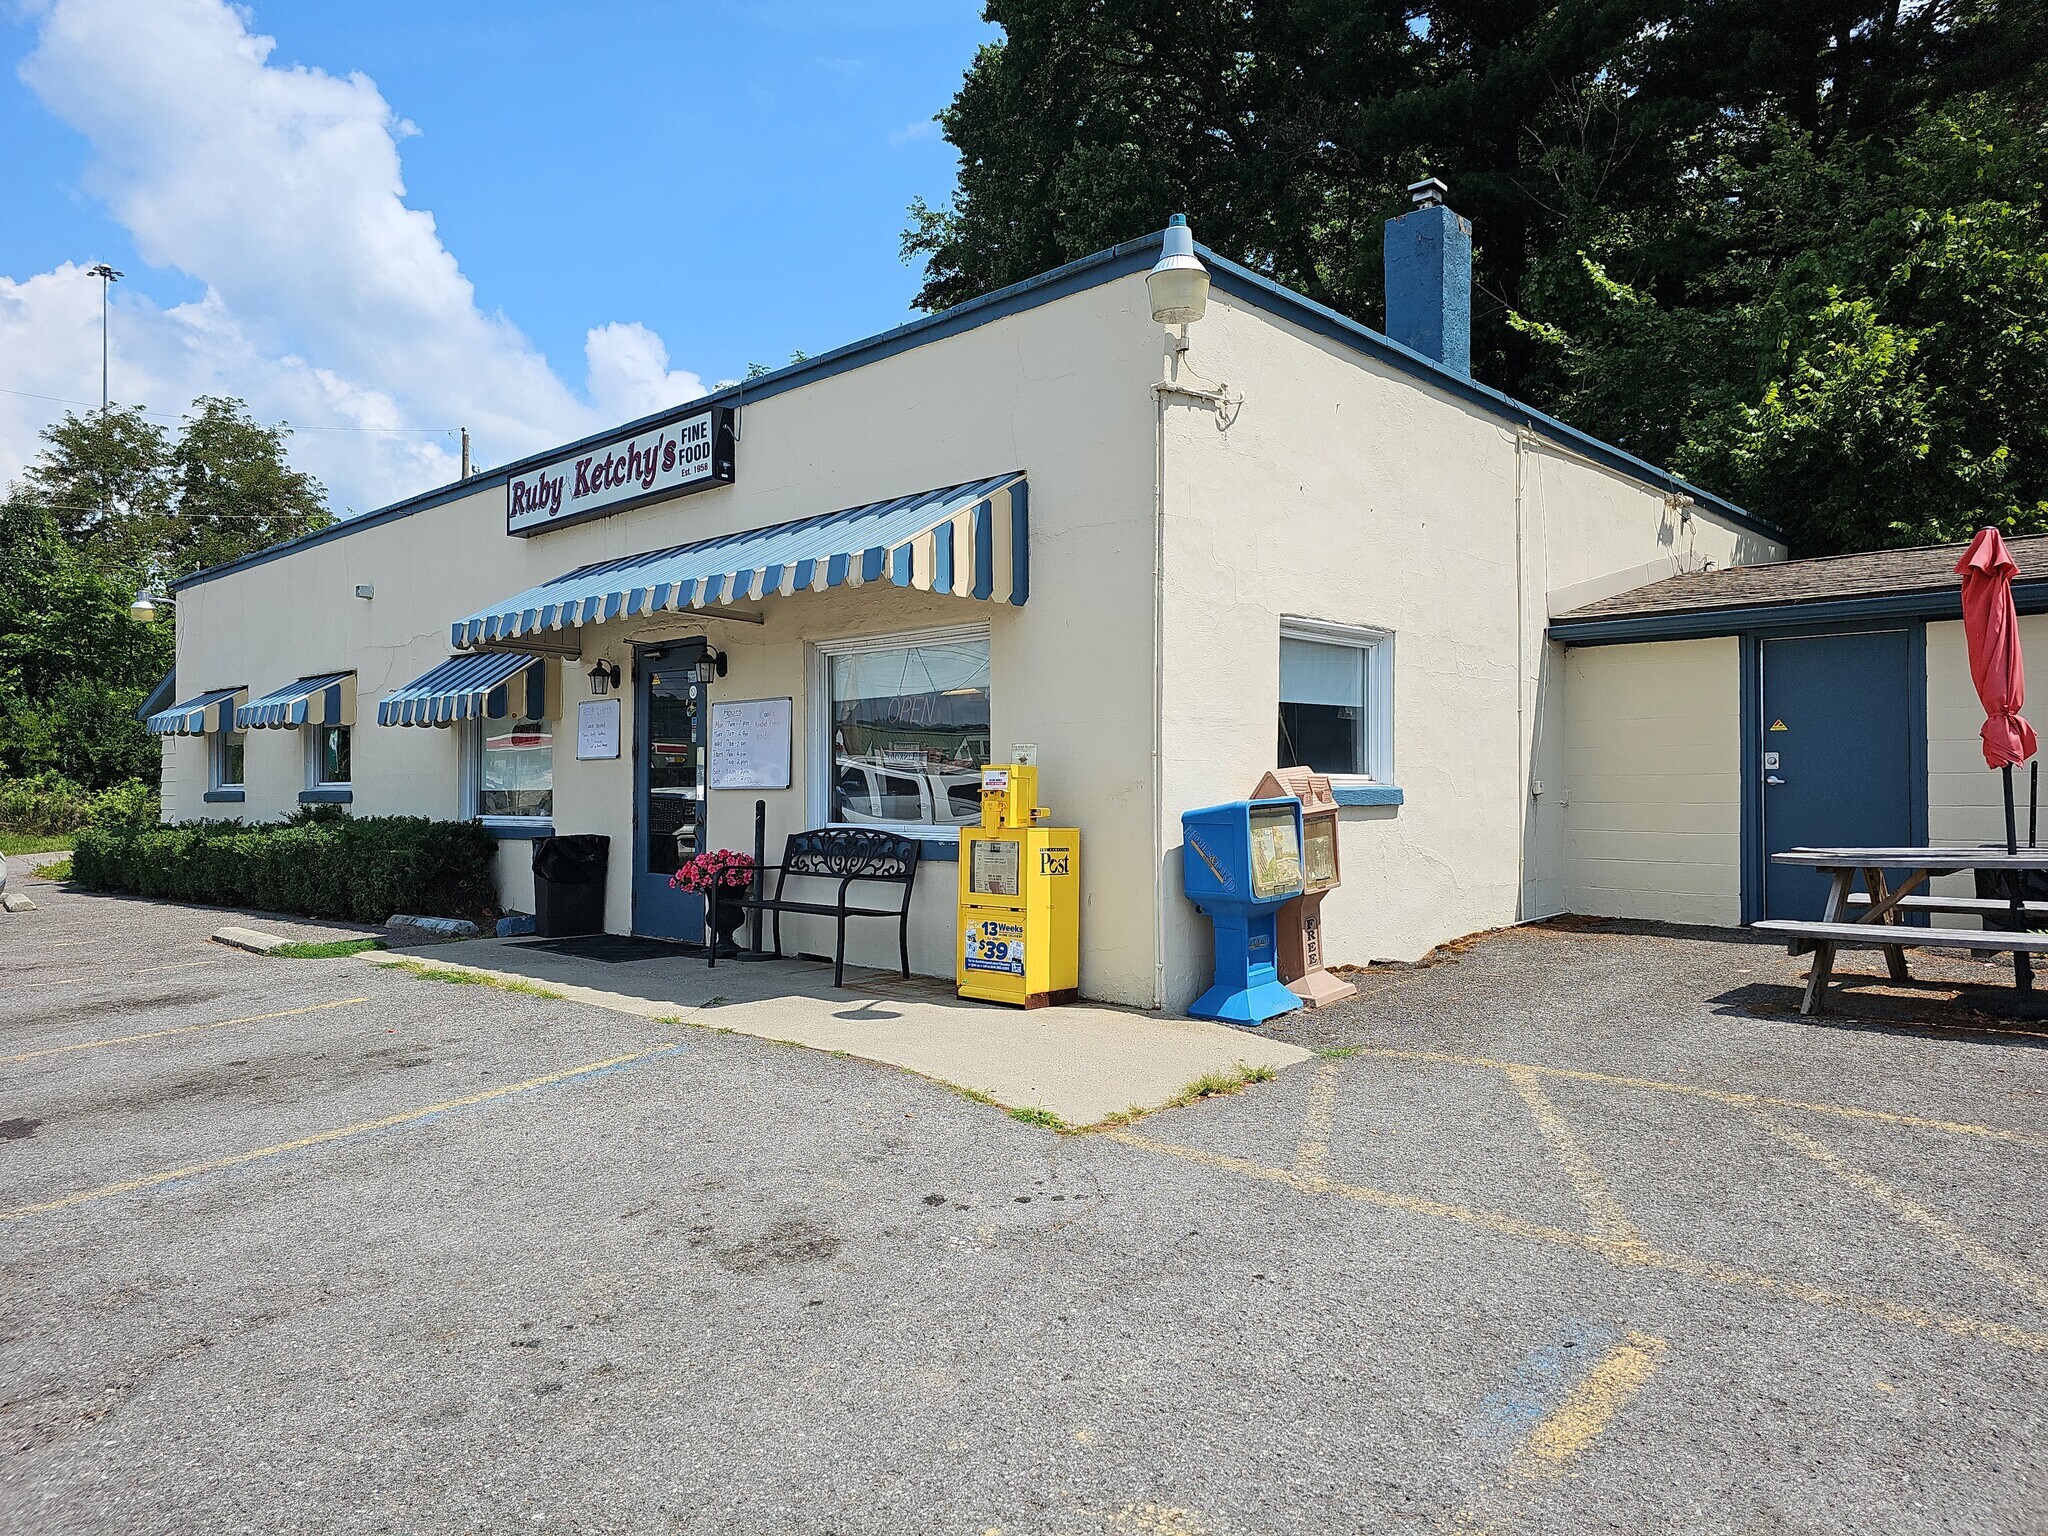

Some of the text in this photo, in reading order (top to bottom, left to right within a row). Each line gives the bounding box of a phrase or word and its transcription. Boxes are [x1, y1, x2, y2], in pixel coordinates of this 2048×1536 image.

[681, 421, 707, 445] FINE
[679, 441, 710, 466] FOOD
[510, 433, 677, 516] Ruby Ketchy's
[681, 463, 708, 477] Est. 1958
[887, 696, 936, 724] OPEN
[1040, 852, 1069, 874] Post
[981, 921, 998, 936] 13
[998, 923, 1023, 933] Weeks
[979, 939, 1008, 960] $39
[1306, 919, 1317, 965] FREE
